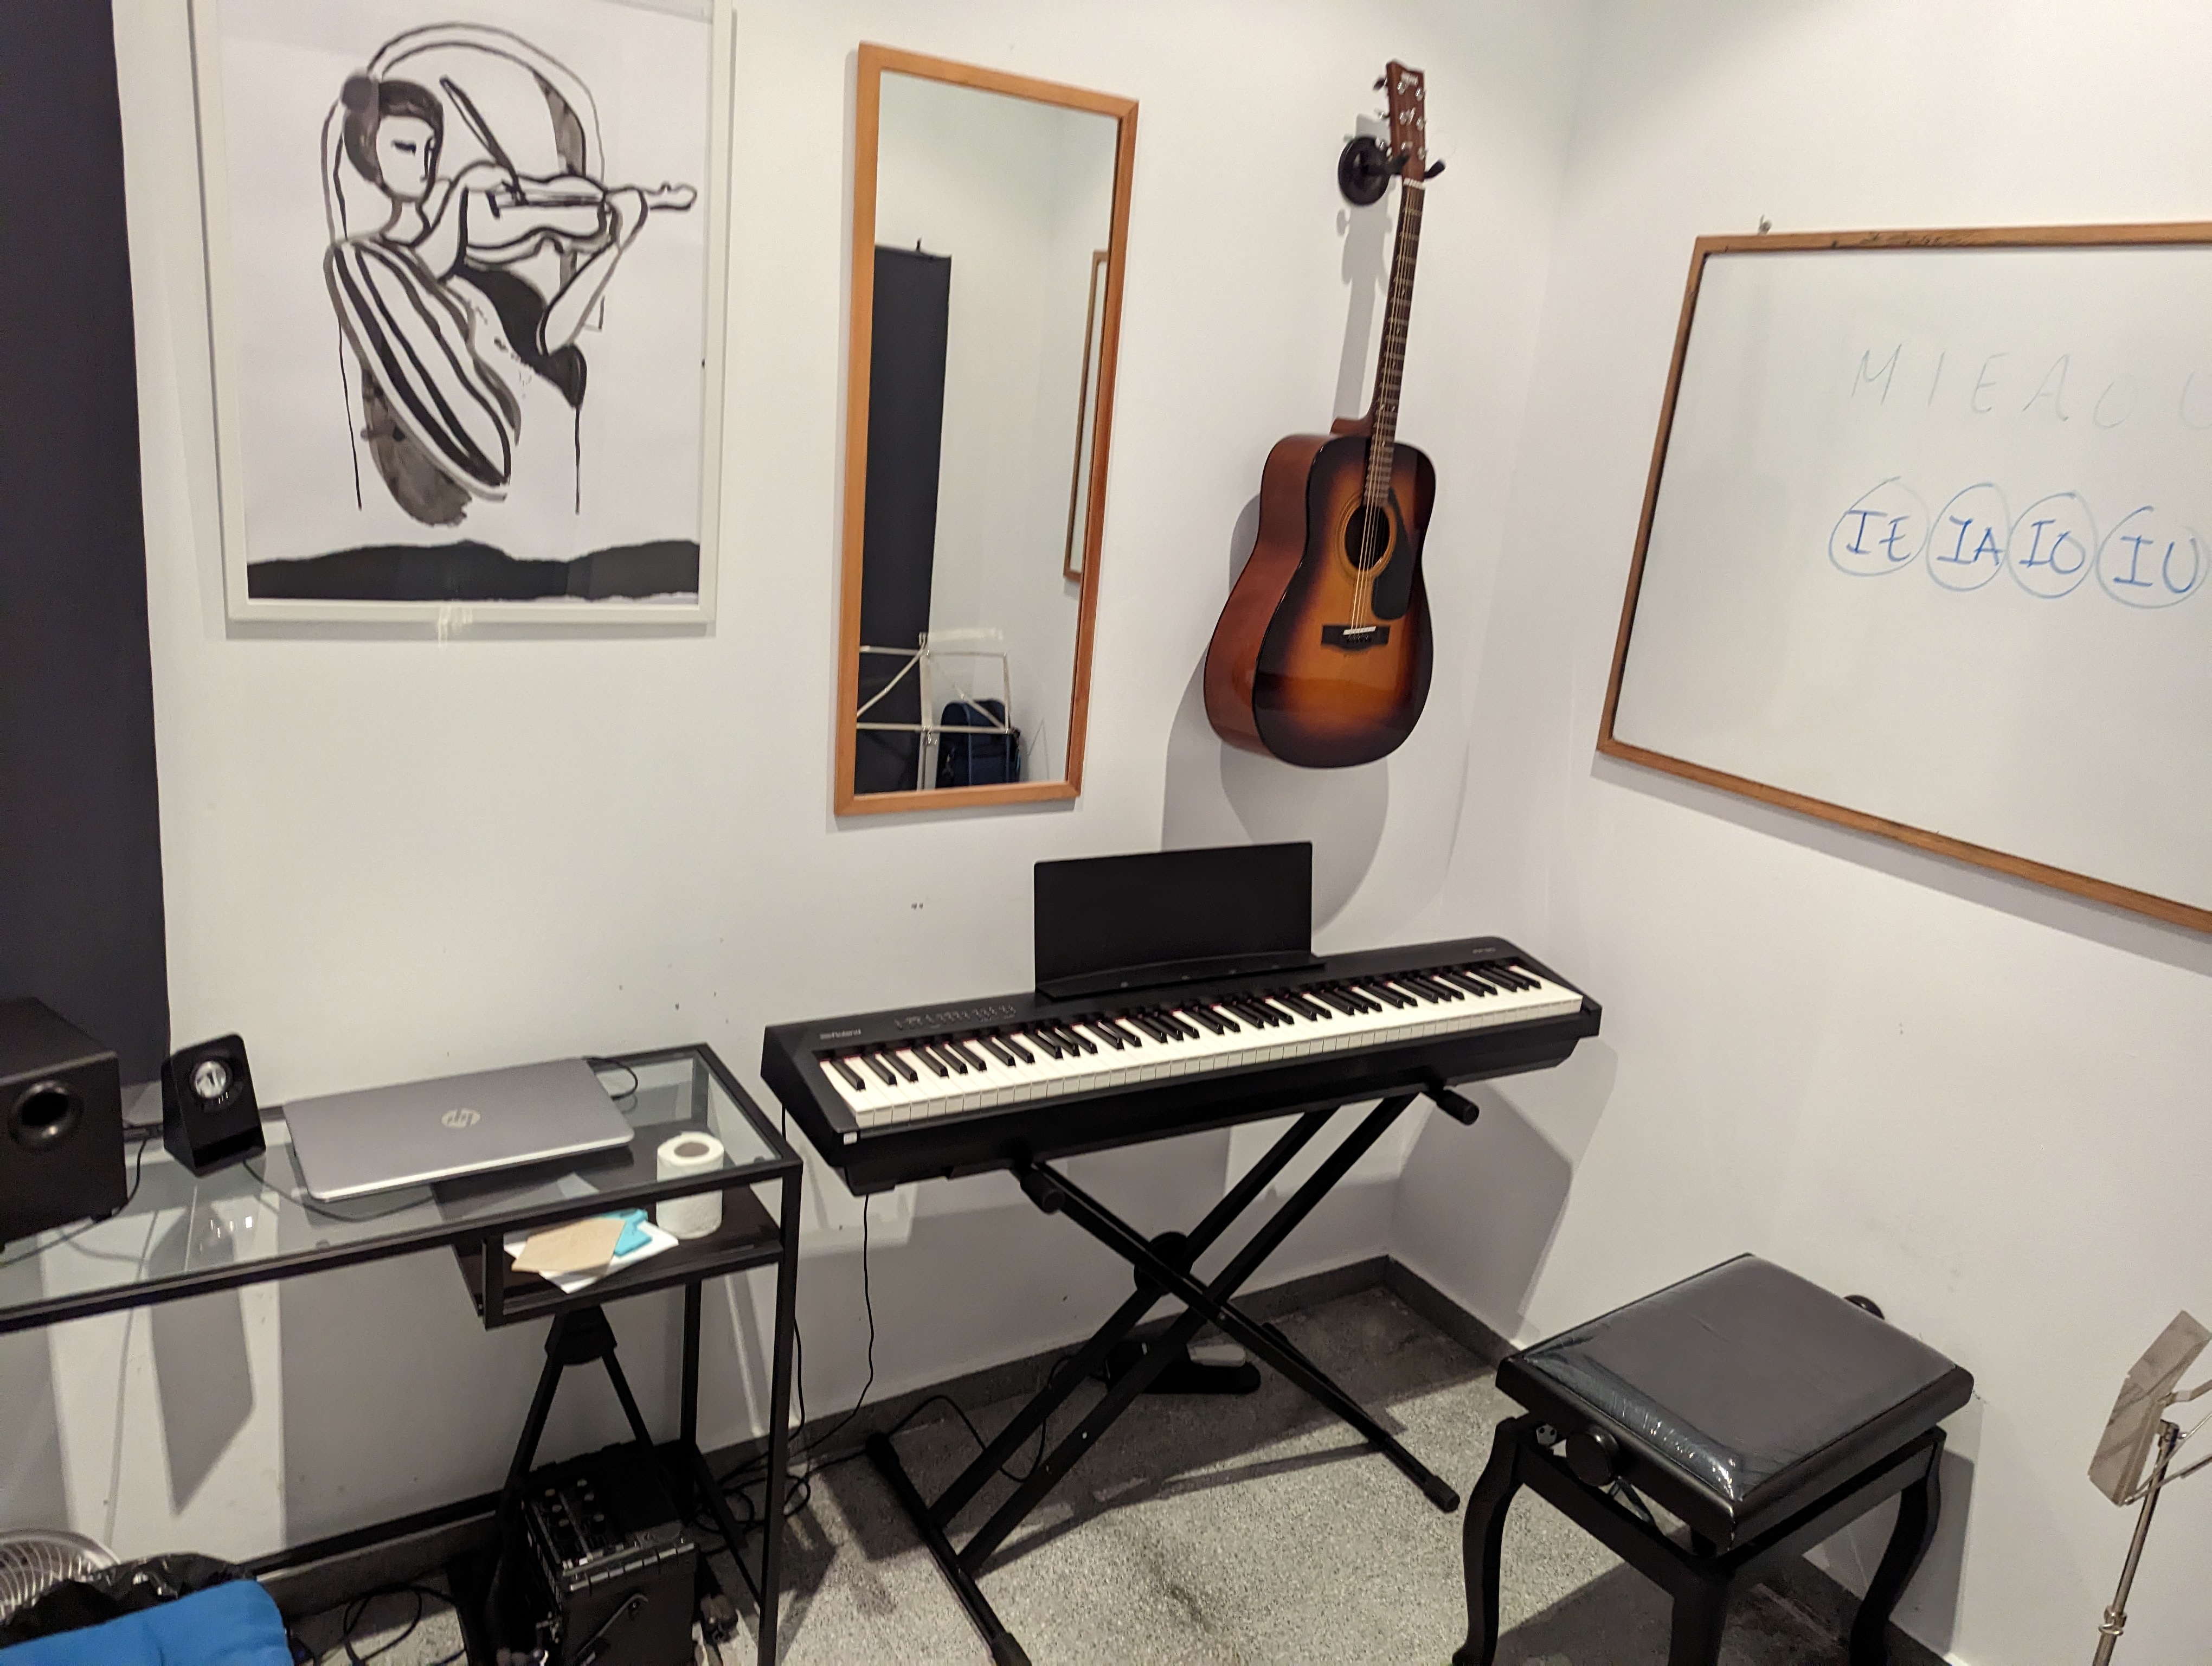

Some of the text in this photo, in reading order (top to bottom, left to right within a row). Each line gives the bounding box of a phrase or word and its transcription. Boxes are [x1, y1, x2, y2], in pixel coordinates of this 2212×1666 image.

[1845, 509, 2200, 593] IE IA IO IU
